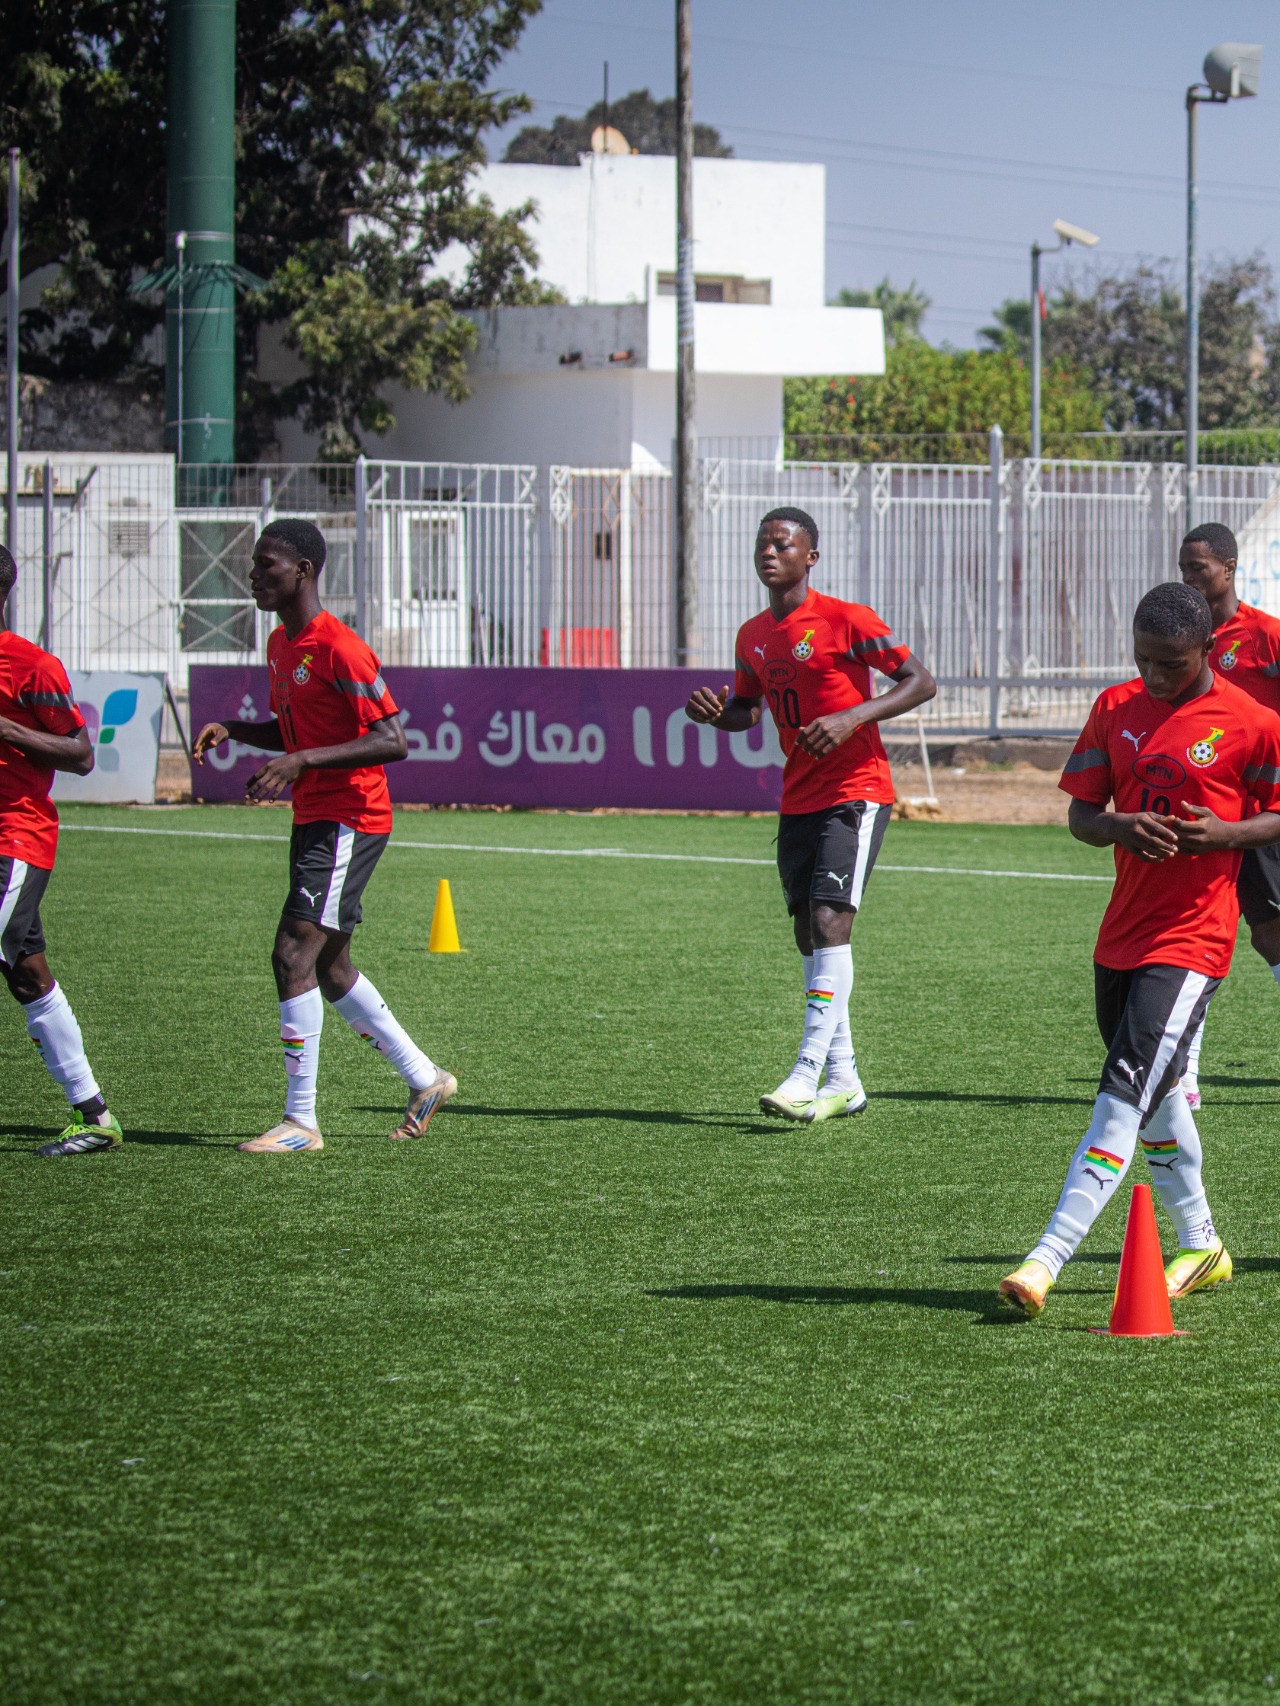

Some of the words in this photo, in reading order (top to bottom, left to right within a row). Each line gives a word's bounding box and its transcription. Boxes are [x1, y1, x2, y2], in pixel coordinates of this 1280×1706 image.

[279, 701, 298, 747] 11
[770, 687, 801, 729] 20
[478, 710, 606, 768] معاك
[1145, 763, 1174, 780] MTN
